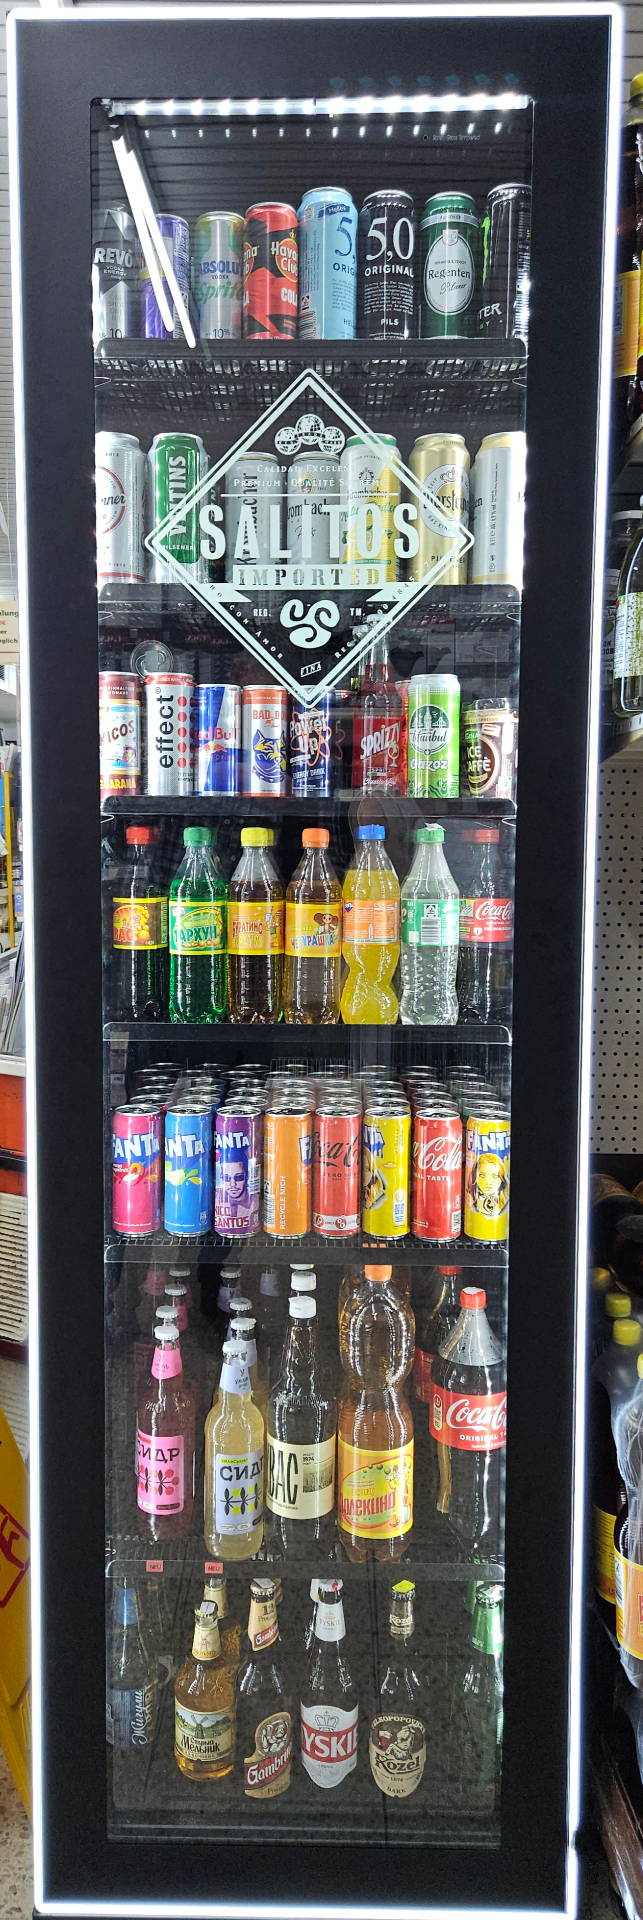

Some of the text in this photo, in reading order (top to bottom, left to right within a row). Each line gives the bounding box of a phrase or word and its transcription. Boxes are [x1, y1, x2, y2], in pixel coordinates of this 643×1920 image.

[366, 217, 415, 262] 5,0
[365, 264, 415, 278] ORIGINAL
[428, 268, 471, 280] Regenten
[233, 478, 281, 488] PREMIUM
[200, 503, 420, 560] SALITOS
[239, 568, 380, 586] IMPORTED
[252, 709, 271, 720] BAD
[155, 694, 174, 769] effect
[214, 727, 237, 741] Bull
[360, 720, 401, 760] SPRIZZY
[410, 758, 449, 772] Gazoz
[232, 920, 264, 938] БУРАТИНО
[291, 934, 335, 950] ЧЕБУРАШКА
[459, 1433, 498, 1442] ORIGINAL
[262, 1602, 275, 1616] 12
[319, 1618, 341, 1627] TYSKIE
[375, 1751, 421, 1774] Kozel
[386, 1786, 407, 1794] DARK
